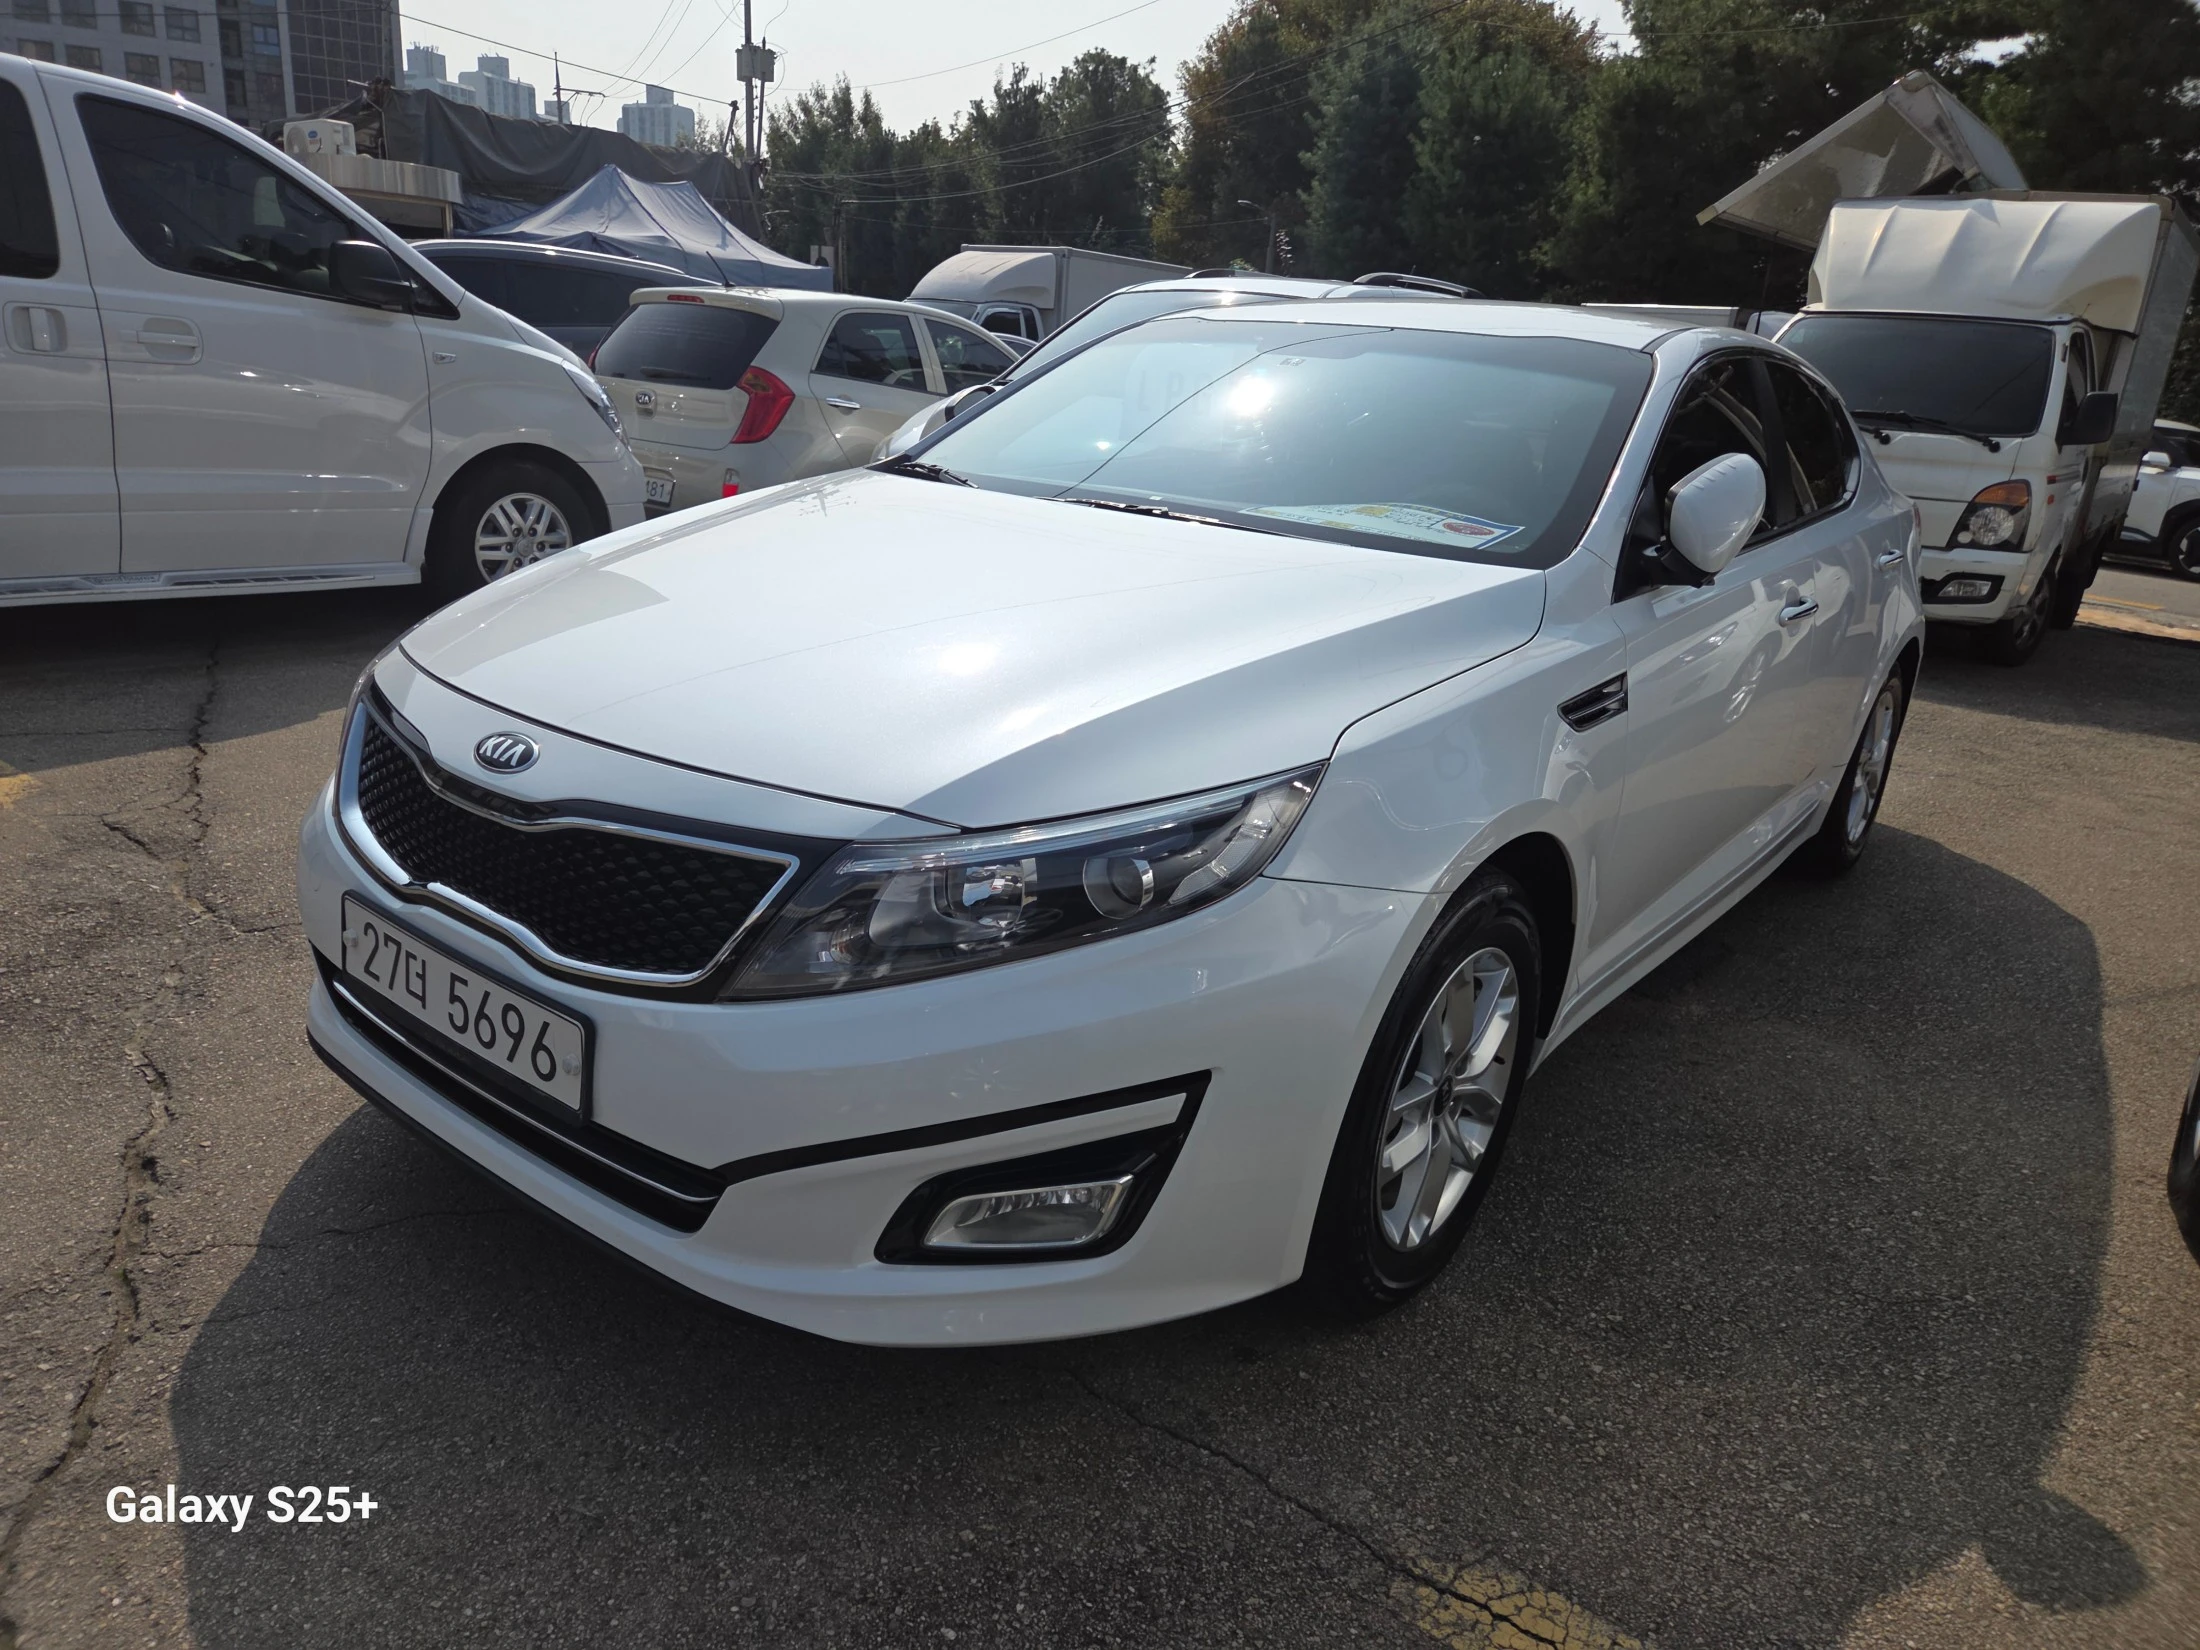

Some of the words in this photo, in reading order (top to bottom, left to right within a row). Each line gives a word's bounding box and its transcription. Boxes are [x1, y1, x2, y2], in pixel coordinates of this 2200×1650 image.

[479, 736, 526, 767] KIA
[363, 922, 426, 1010] 27더
[448, 972, 556, 1082] 5696
